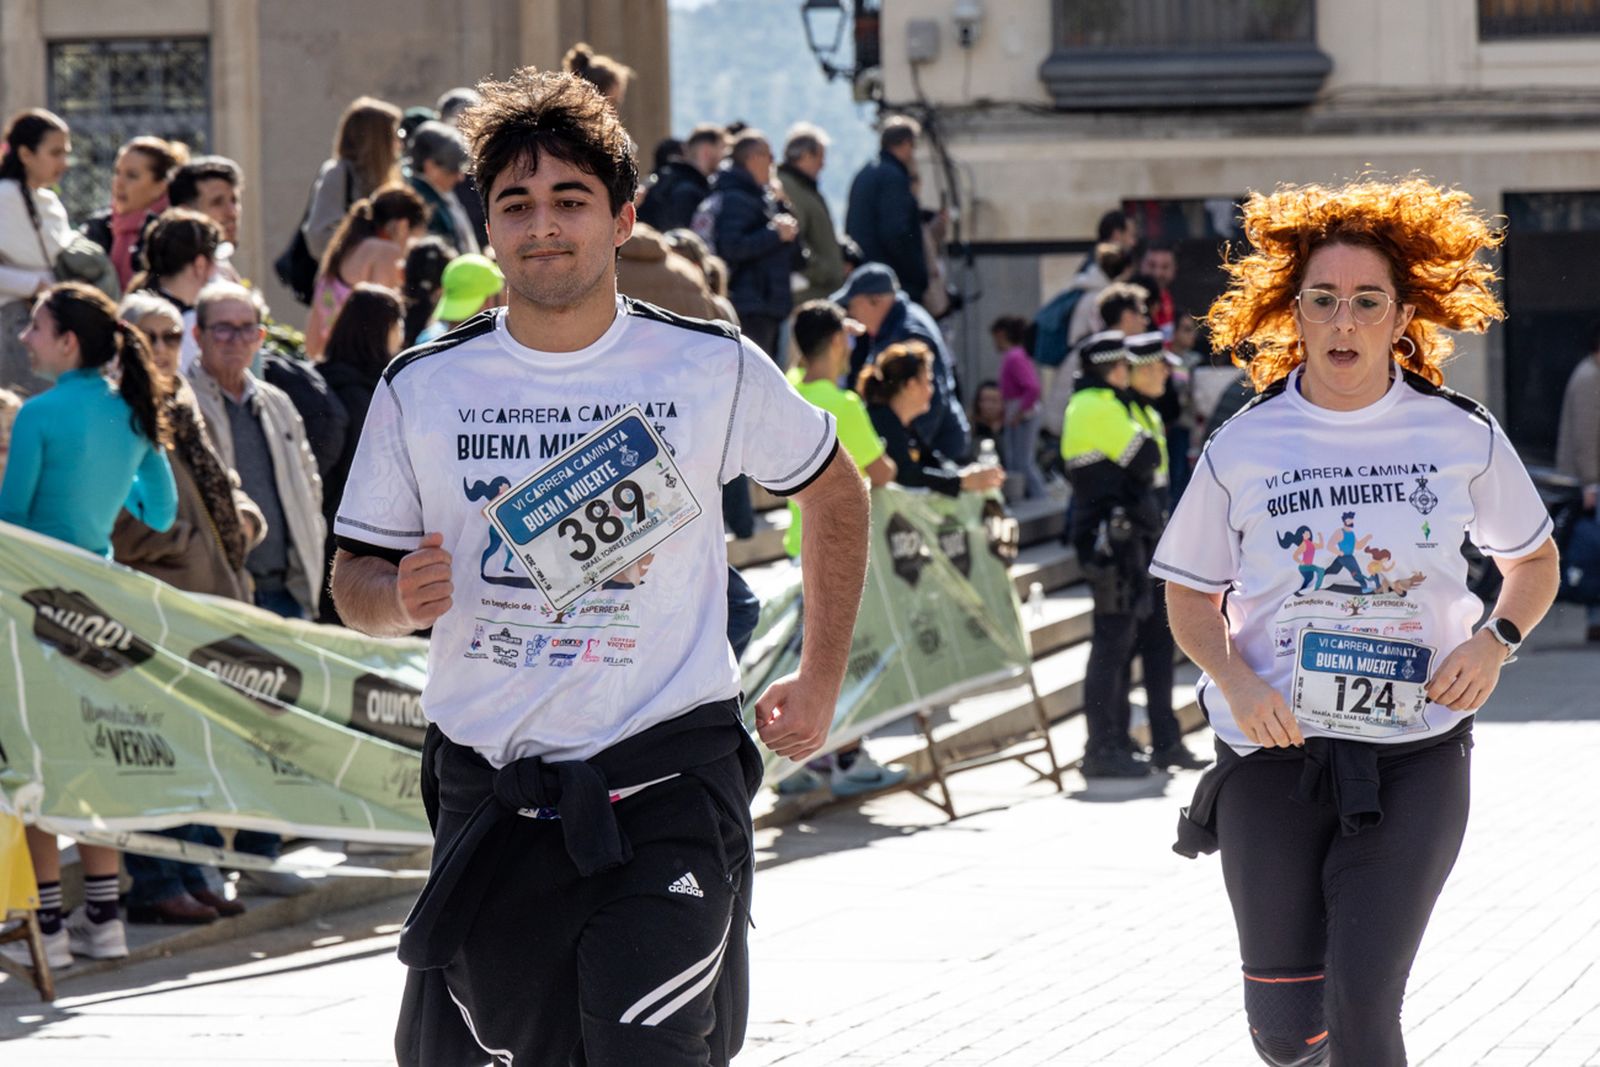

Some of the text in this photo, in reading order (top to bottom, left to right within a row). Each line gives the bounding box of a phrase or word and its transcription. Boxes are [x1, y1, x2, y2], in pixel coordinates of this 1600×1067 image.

[458, 401, 678, 424] VI CARRERA CAMATA
[457, 434, 531, 460] BUENA
[512, 499, 525, 511] VI
[526, 466, 574, 503] CARRERA
[573, 429, 629, 471] CAMINATA
[1265, 463, 1438, 489] VI CARRERA CAMINATA
[522, 460, 619, 533] BUENA MUERTE
[1267, 482, 1406, 518] BUENA MUERTE
[557, 480, 646, 562] 389
[581, 553, 603, 572] ISRAEL
[601, 539, 625, 557] TORRES
[1318, 637, 1418, 658] VI CARRERA CAMINATA
[1316, 652, 1354, 671] BUENA
[1357, 656, 1398, 676] MUERTE
[366, 689, 429, 728] owna
[1334, 675, 1395, 717] 124
[1332, 712, 1342, 720] DEL
[1343, 713, 1358, 722] MAR
[668, 884, 704, 898] adidas
